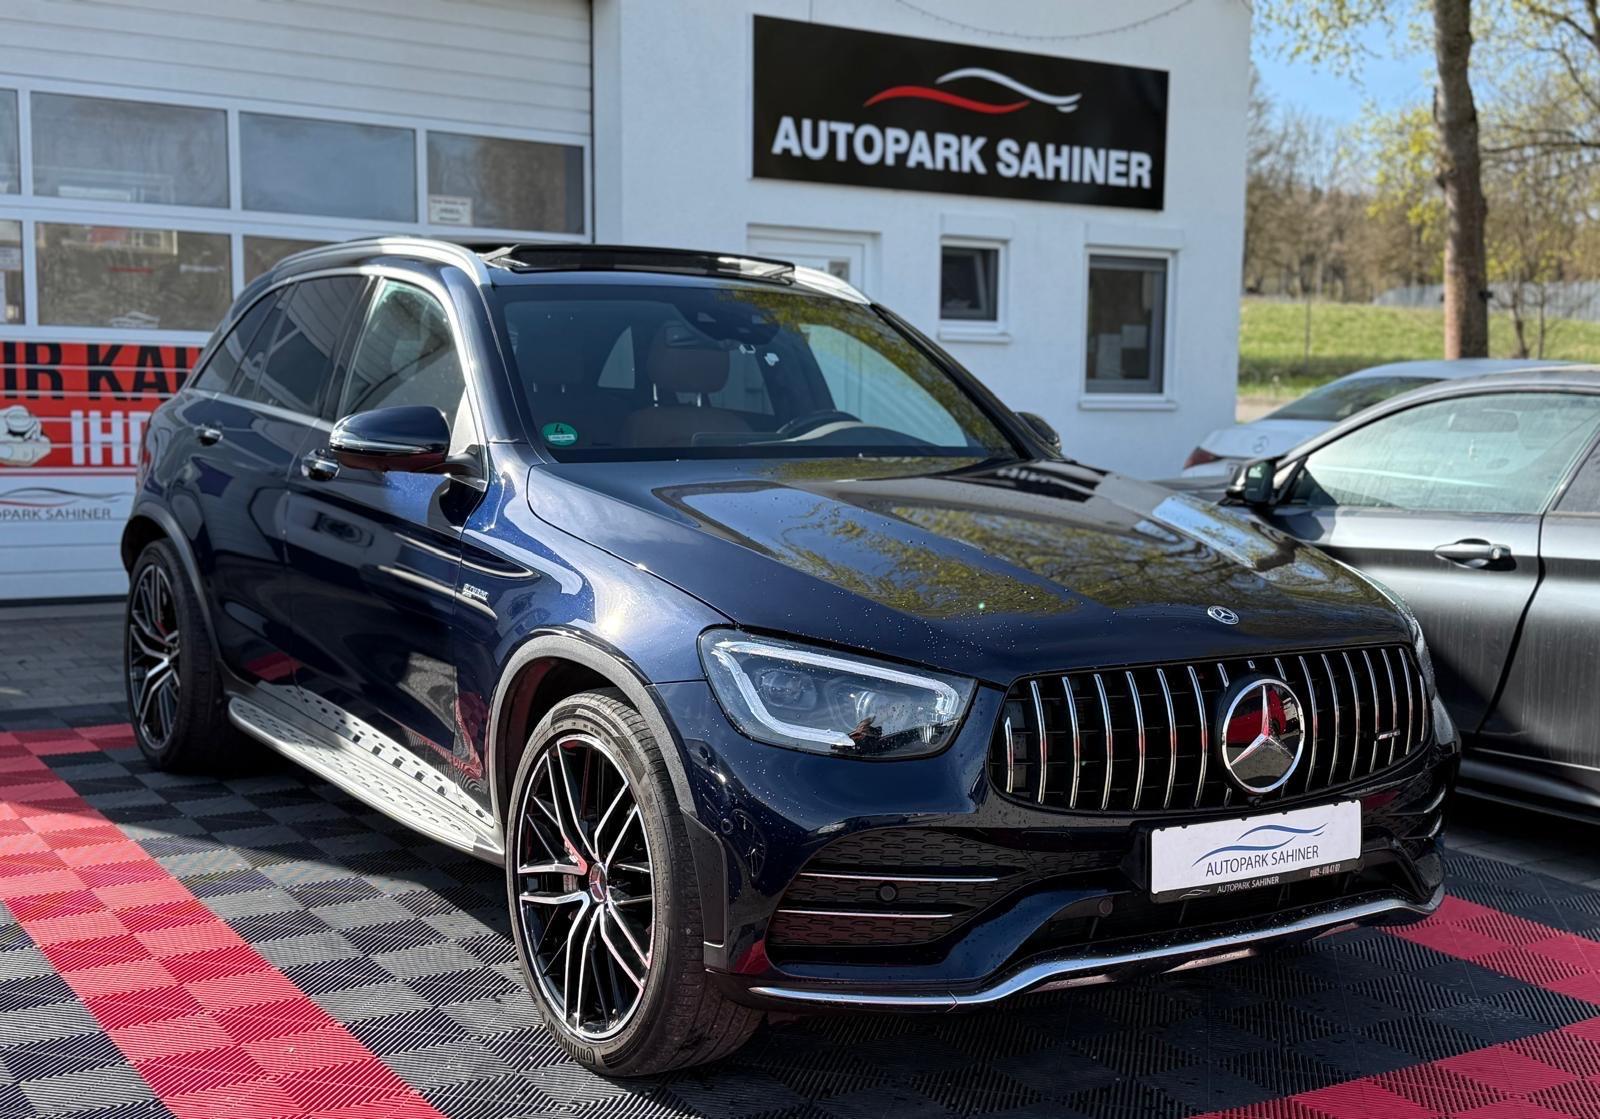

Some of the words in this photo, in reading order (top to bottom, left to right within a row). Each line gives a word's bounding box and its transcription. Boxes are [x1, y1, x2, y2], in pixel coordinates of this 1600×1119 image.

[772, 116, 987, 174] AUTOPARK
[996, 139, 1152, 189] SAHINER
[554, 423, 564, 434] 4
[46, 507, 111, 520] SAHINER
[1206, 853, 1269, 877] AUTOPARK
[1271, 845, 1319, 866] SAHINER
[1217, 880, 1251, 894] AUTOPARK
[1251, 876, 1280, 888] SAHINER
